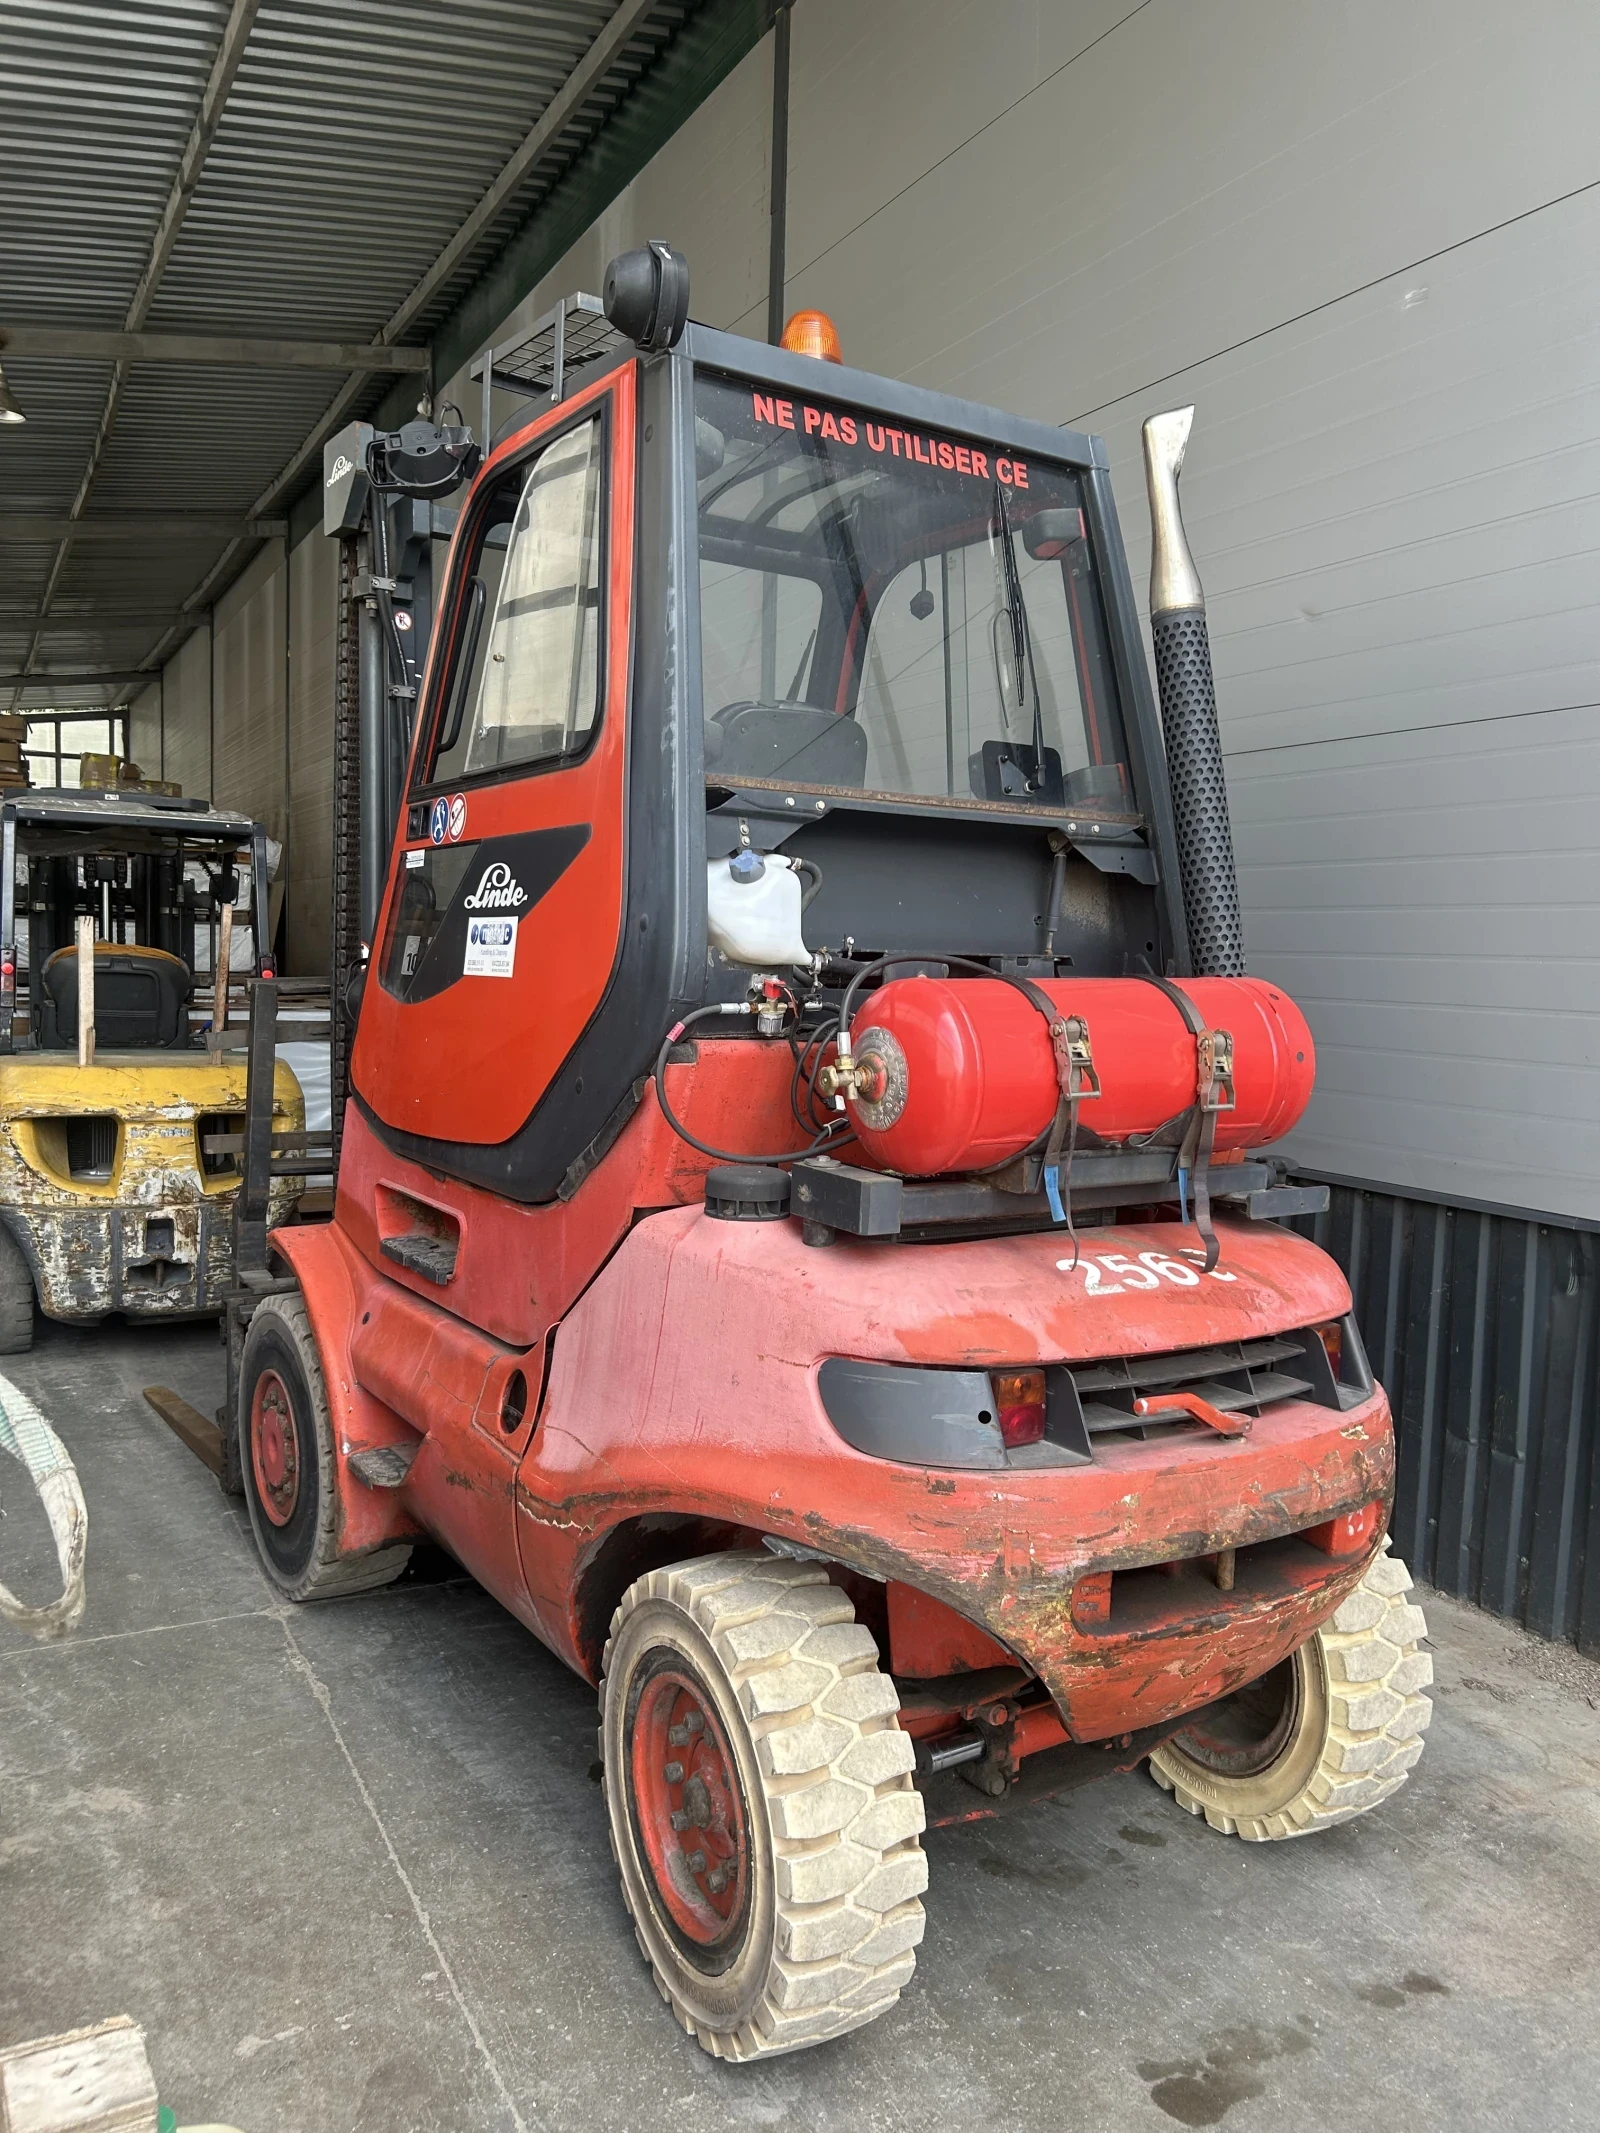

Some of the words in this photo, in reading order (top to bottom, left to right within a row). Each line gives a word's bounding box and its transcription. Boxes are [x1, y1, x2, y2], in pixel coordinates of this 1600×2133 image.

[752, 393, 795, 430] NE
[803, 406, 858, 445] PAS
[866, 422, 989, 479] UTILISER
[995, 457, 1029, 489] CE
[326, 455, 353, 488] Linde
[464, 862, 528, 909] Linde
